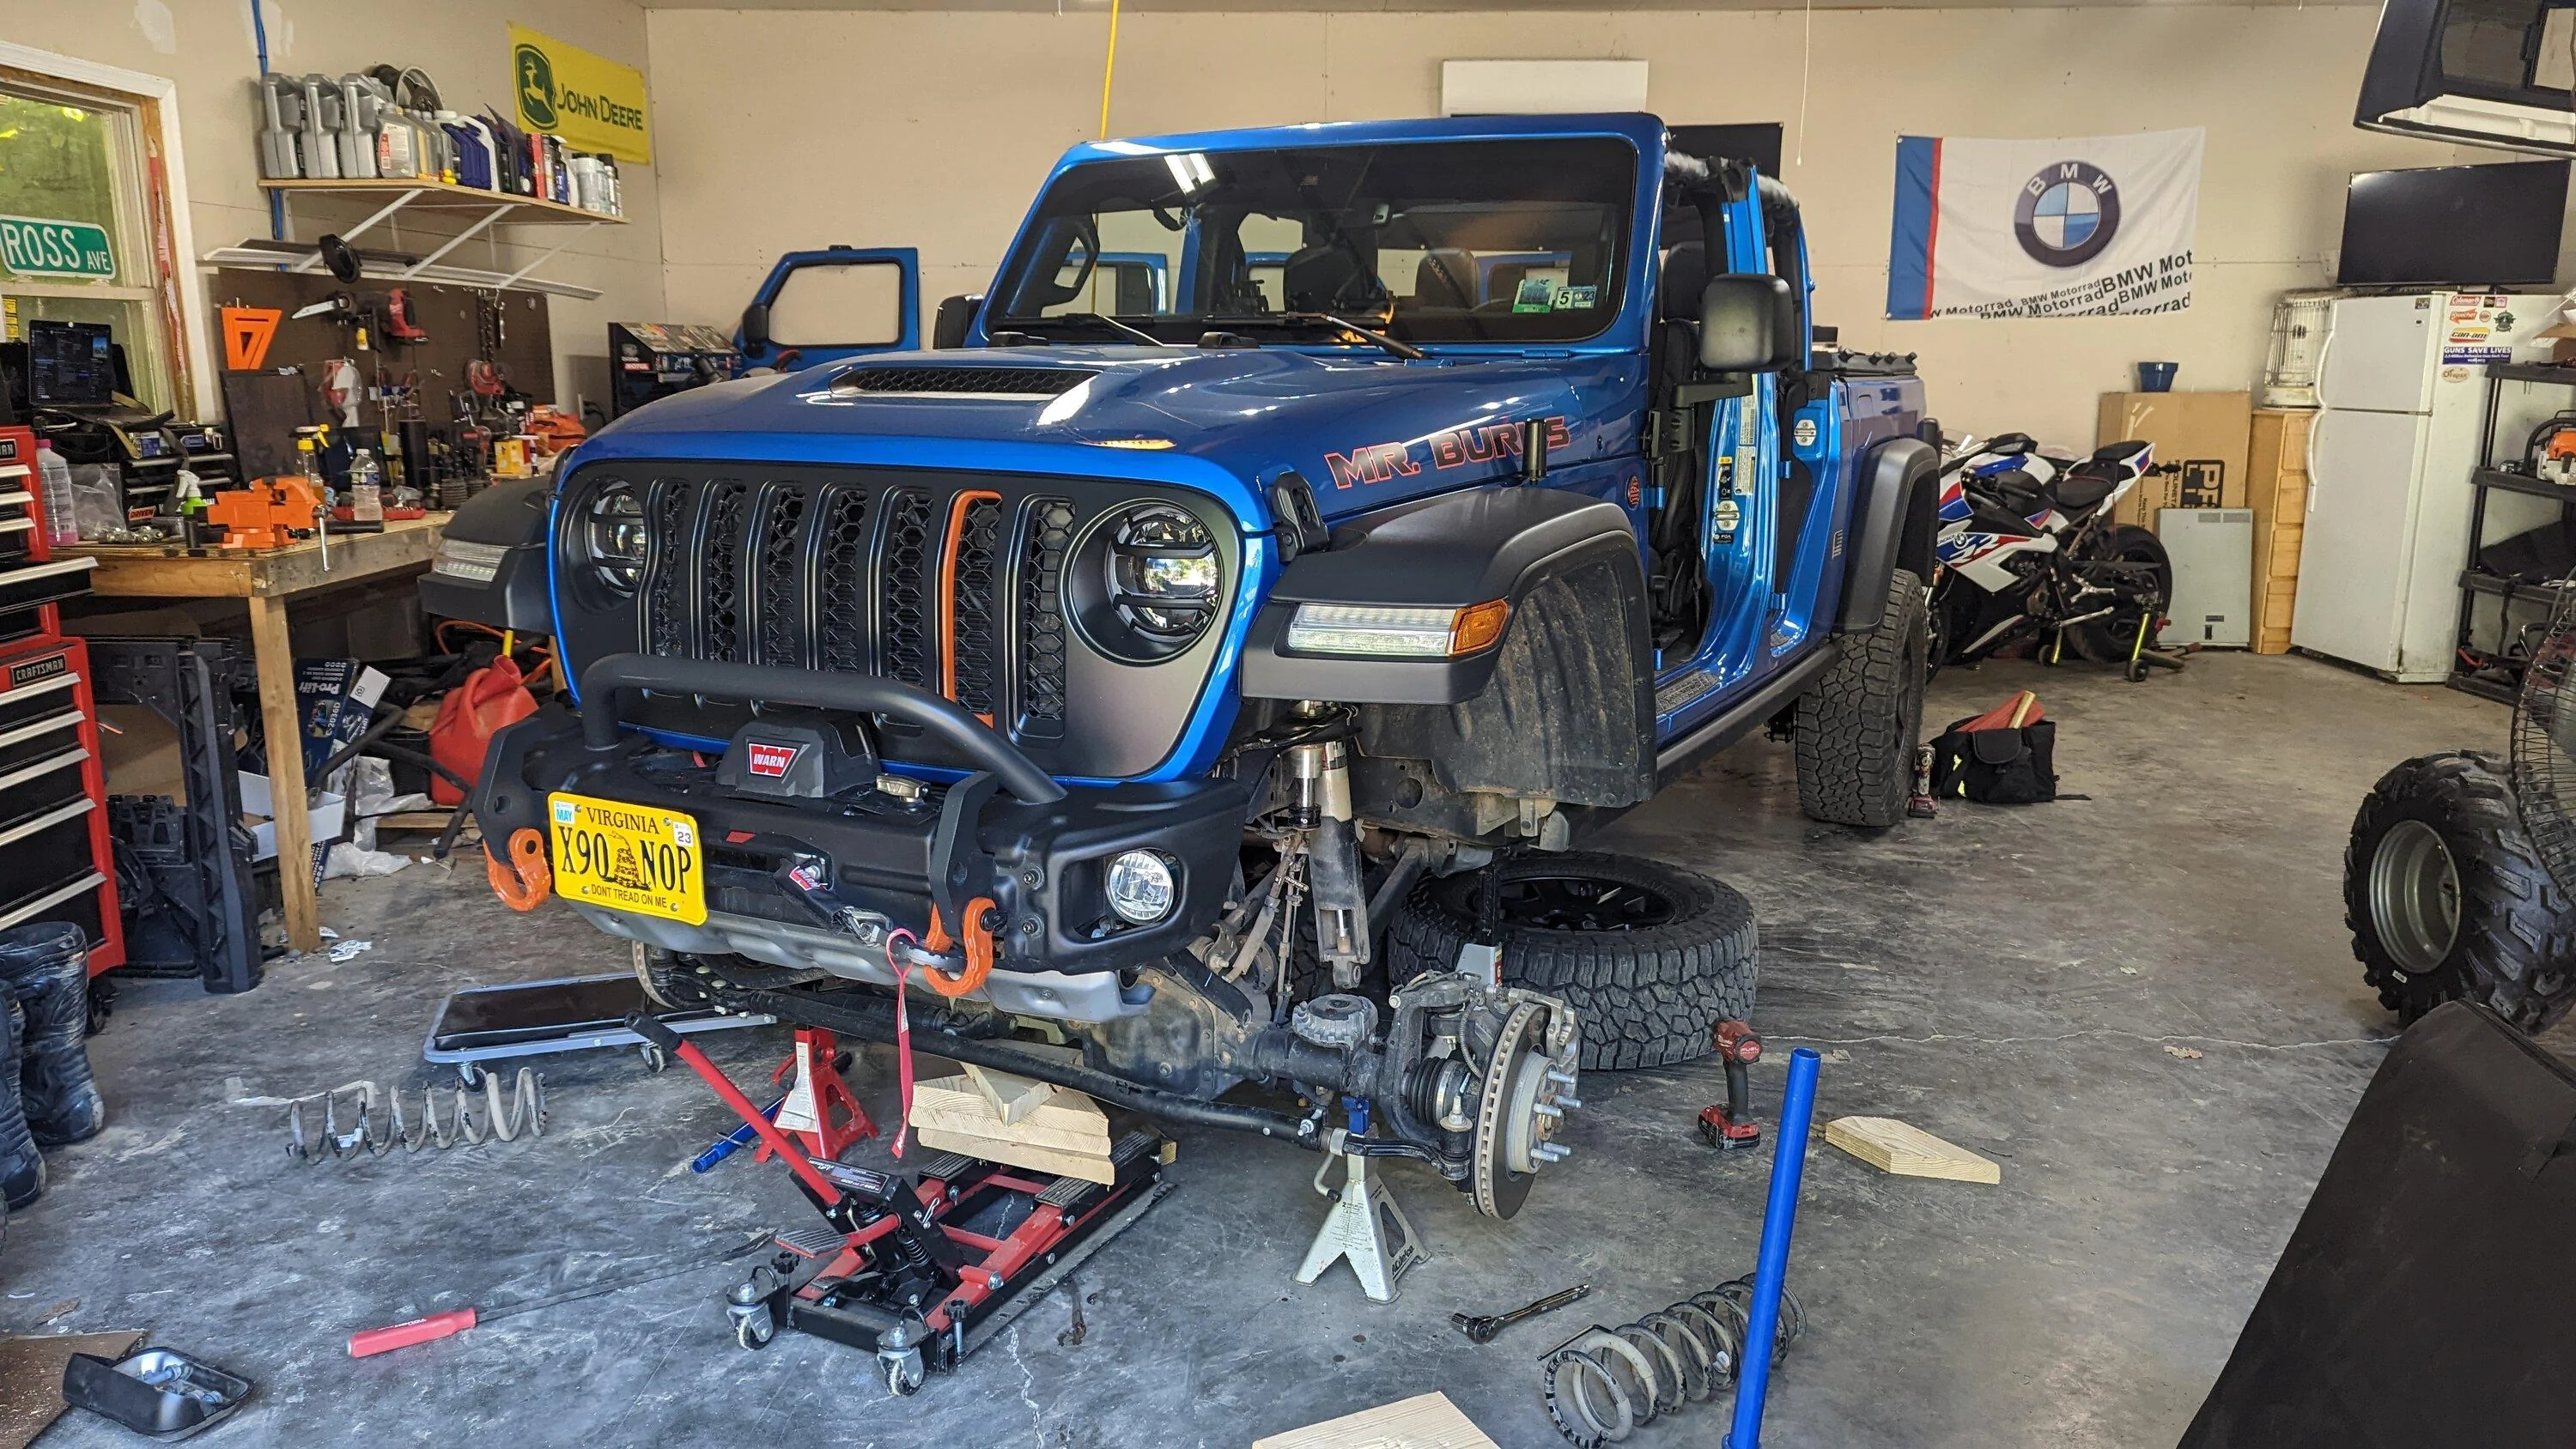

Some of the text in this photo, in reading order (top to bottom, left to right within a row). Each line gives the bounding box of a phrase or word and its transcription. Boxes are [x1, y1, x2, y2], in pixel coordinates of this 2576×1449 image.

[556, 82, 643, 130] JOHN DEERE
[2026, 163, 2112, 197] BMW
[2, 223, 111, 271] ROSS AVE
[2102, 262, 2153, 294] BMW
[1559, 291, 1570, 305] 5
[1980, 288, 2104, 319] BMW Motorrad
[2021, 278, 2100, 306] BMW Motorrad
[2118, 280, 2157, 304] BMW
[1946, 299, 2013, 315] Motorrad
[1323, 415, 1571, 489] MR. BURS
[15, 659, 64, 681] CRAFTSMAN
[325, 702, 341, 736] C-2036D
[753, 753, 786, 767] WARN
[556, 809, 573, 822] MAY
[586, 807, 660, 834] VIRGINIA
[677, 831, 692, 843] 23
[558, 826, 692, 894] X90 NOP
[591, 884, 667, 908] DONT TREAD ON ME
